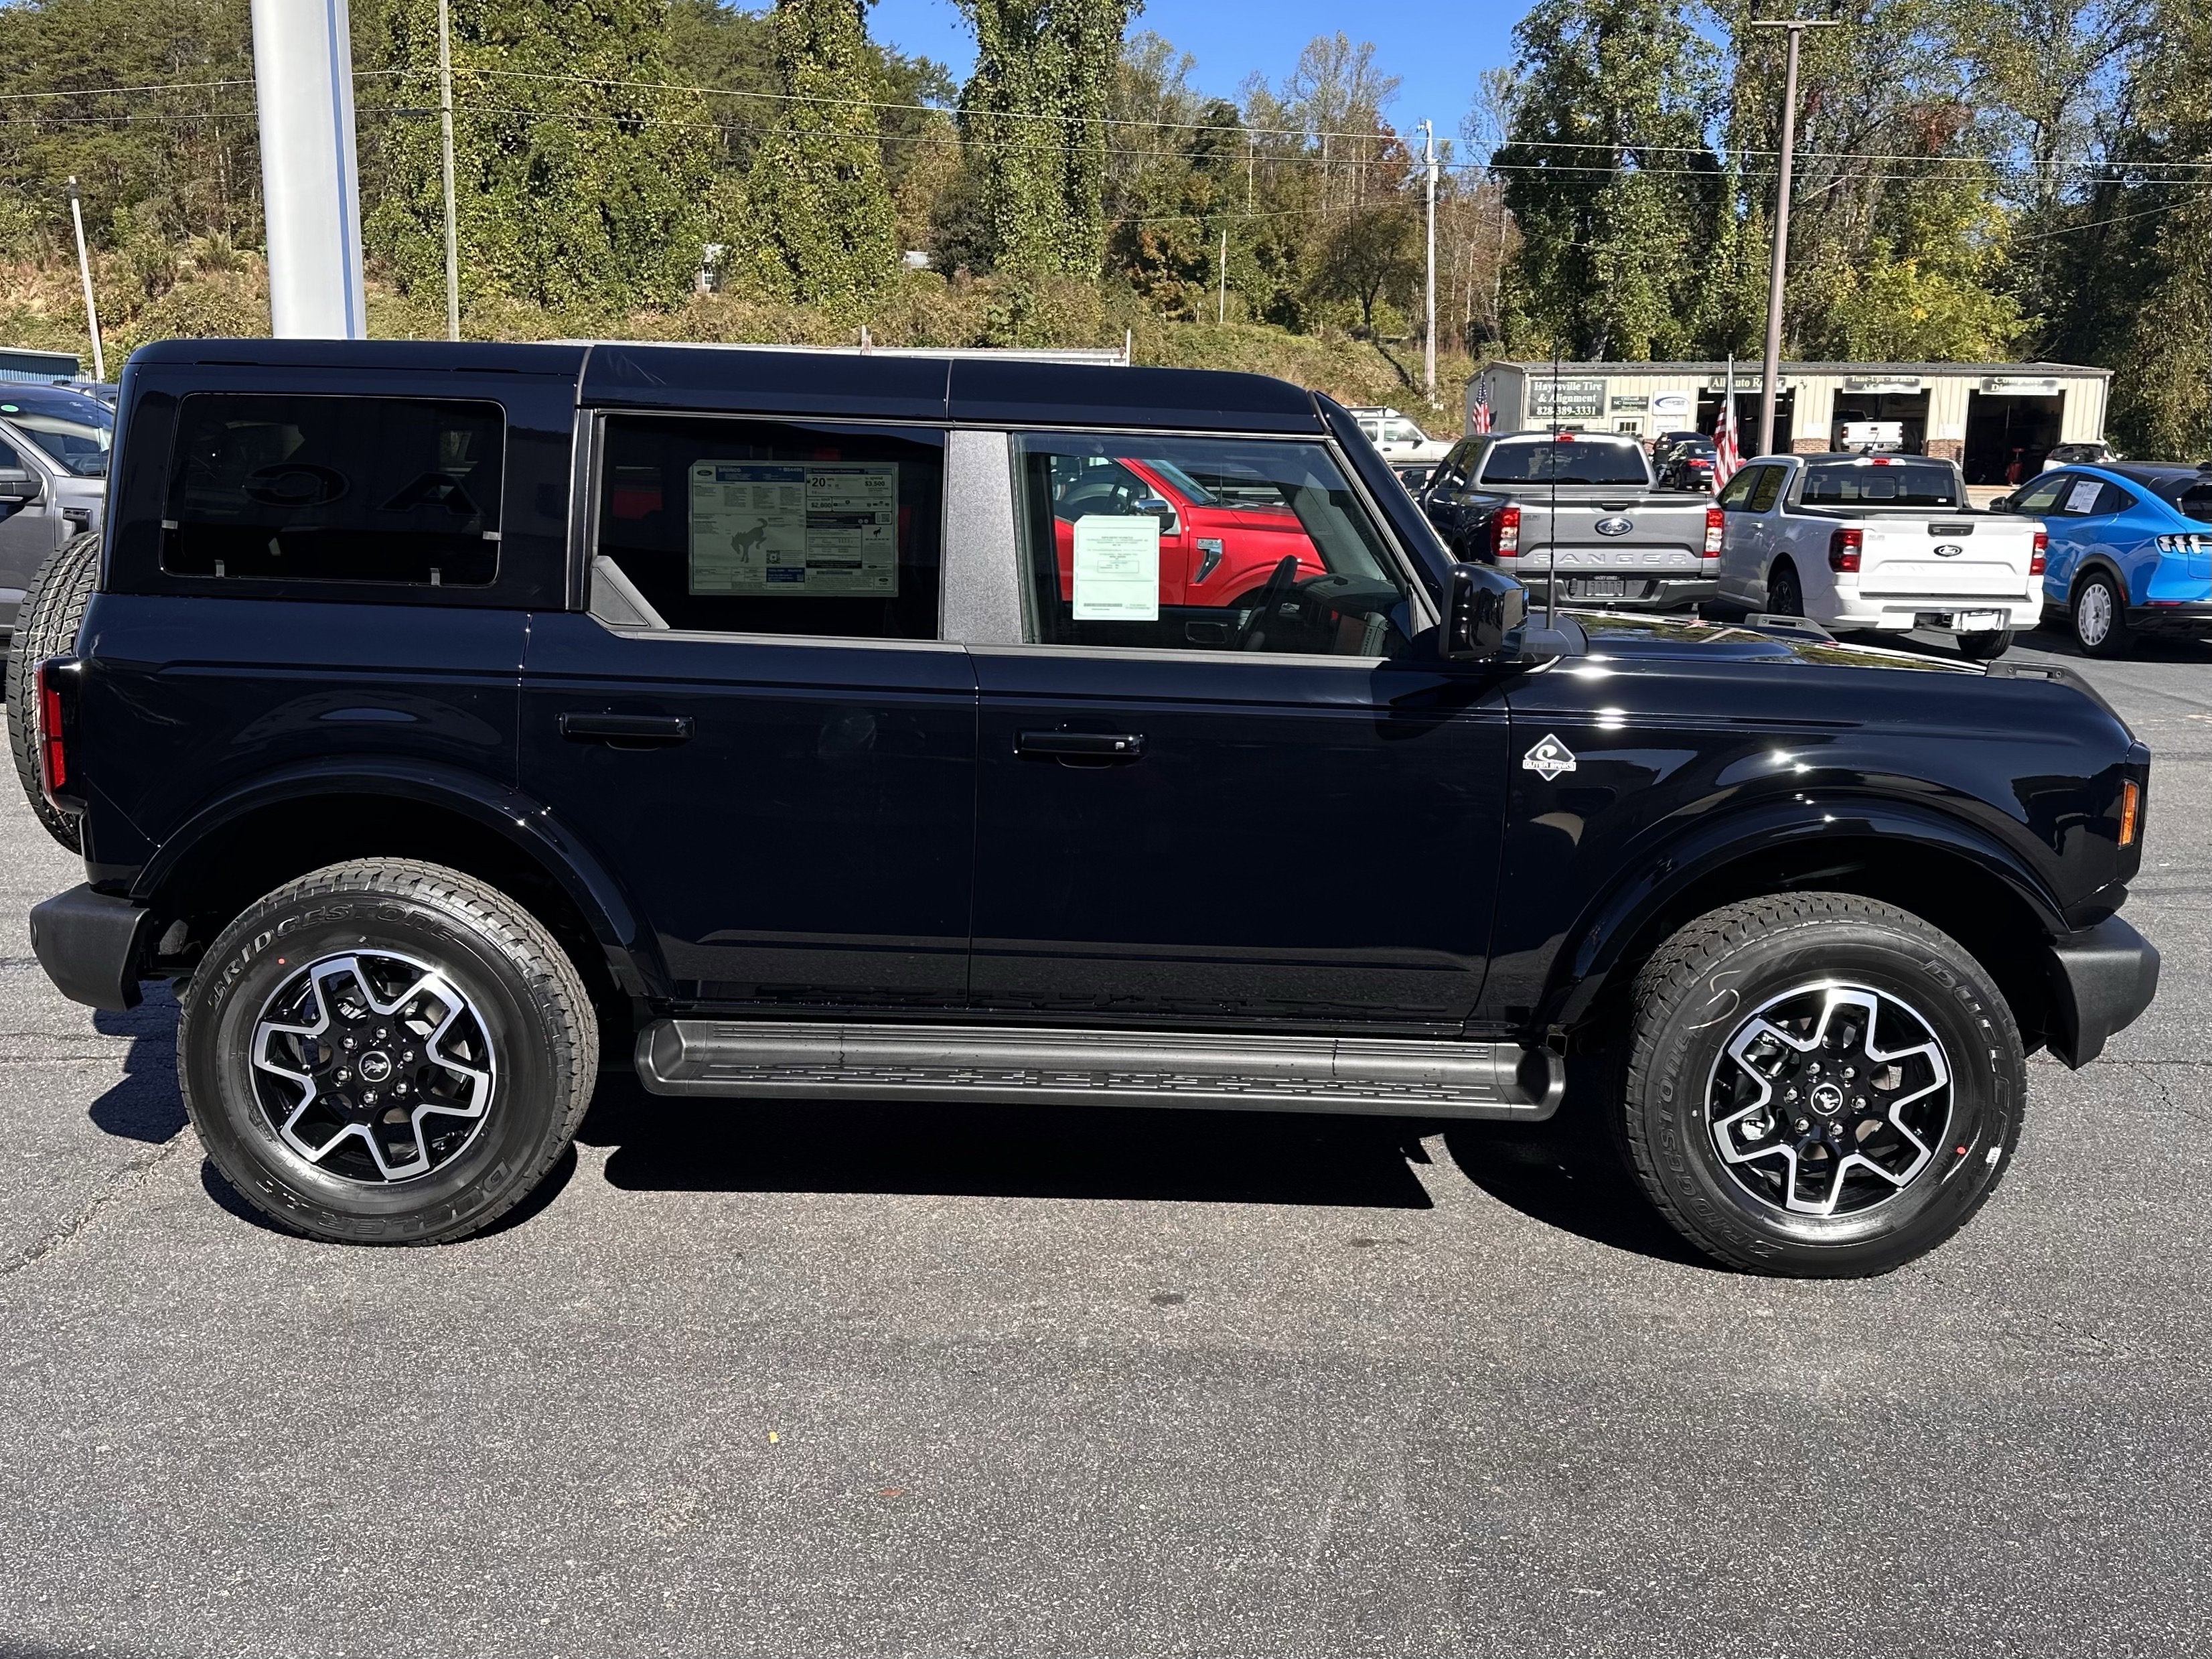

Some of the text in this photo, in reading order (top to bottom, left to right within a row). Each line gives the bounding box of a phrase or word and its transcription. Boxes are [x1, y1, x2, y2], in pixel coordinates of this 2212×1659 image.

[1582, 381, 1603, 391] Tire
[1712, 377, 1784, 387] All uto Rir
[1538, 393, 1597, 405] & Alignment
[1536, 405, 1596, 415] 828-389-3331
[812, 477, 826, 488] 20
[1534, 553, 1687, 565] RANGER
[209, 903, 458, 1014] BRIDGESTONE
[1922, 960, 2010, 1148] DUELER
[1655, 1025, 1784, 1258] BRIDGESTONE
[318, 1159, 513, 1234] DUELER
